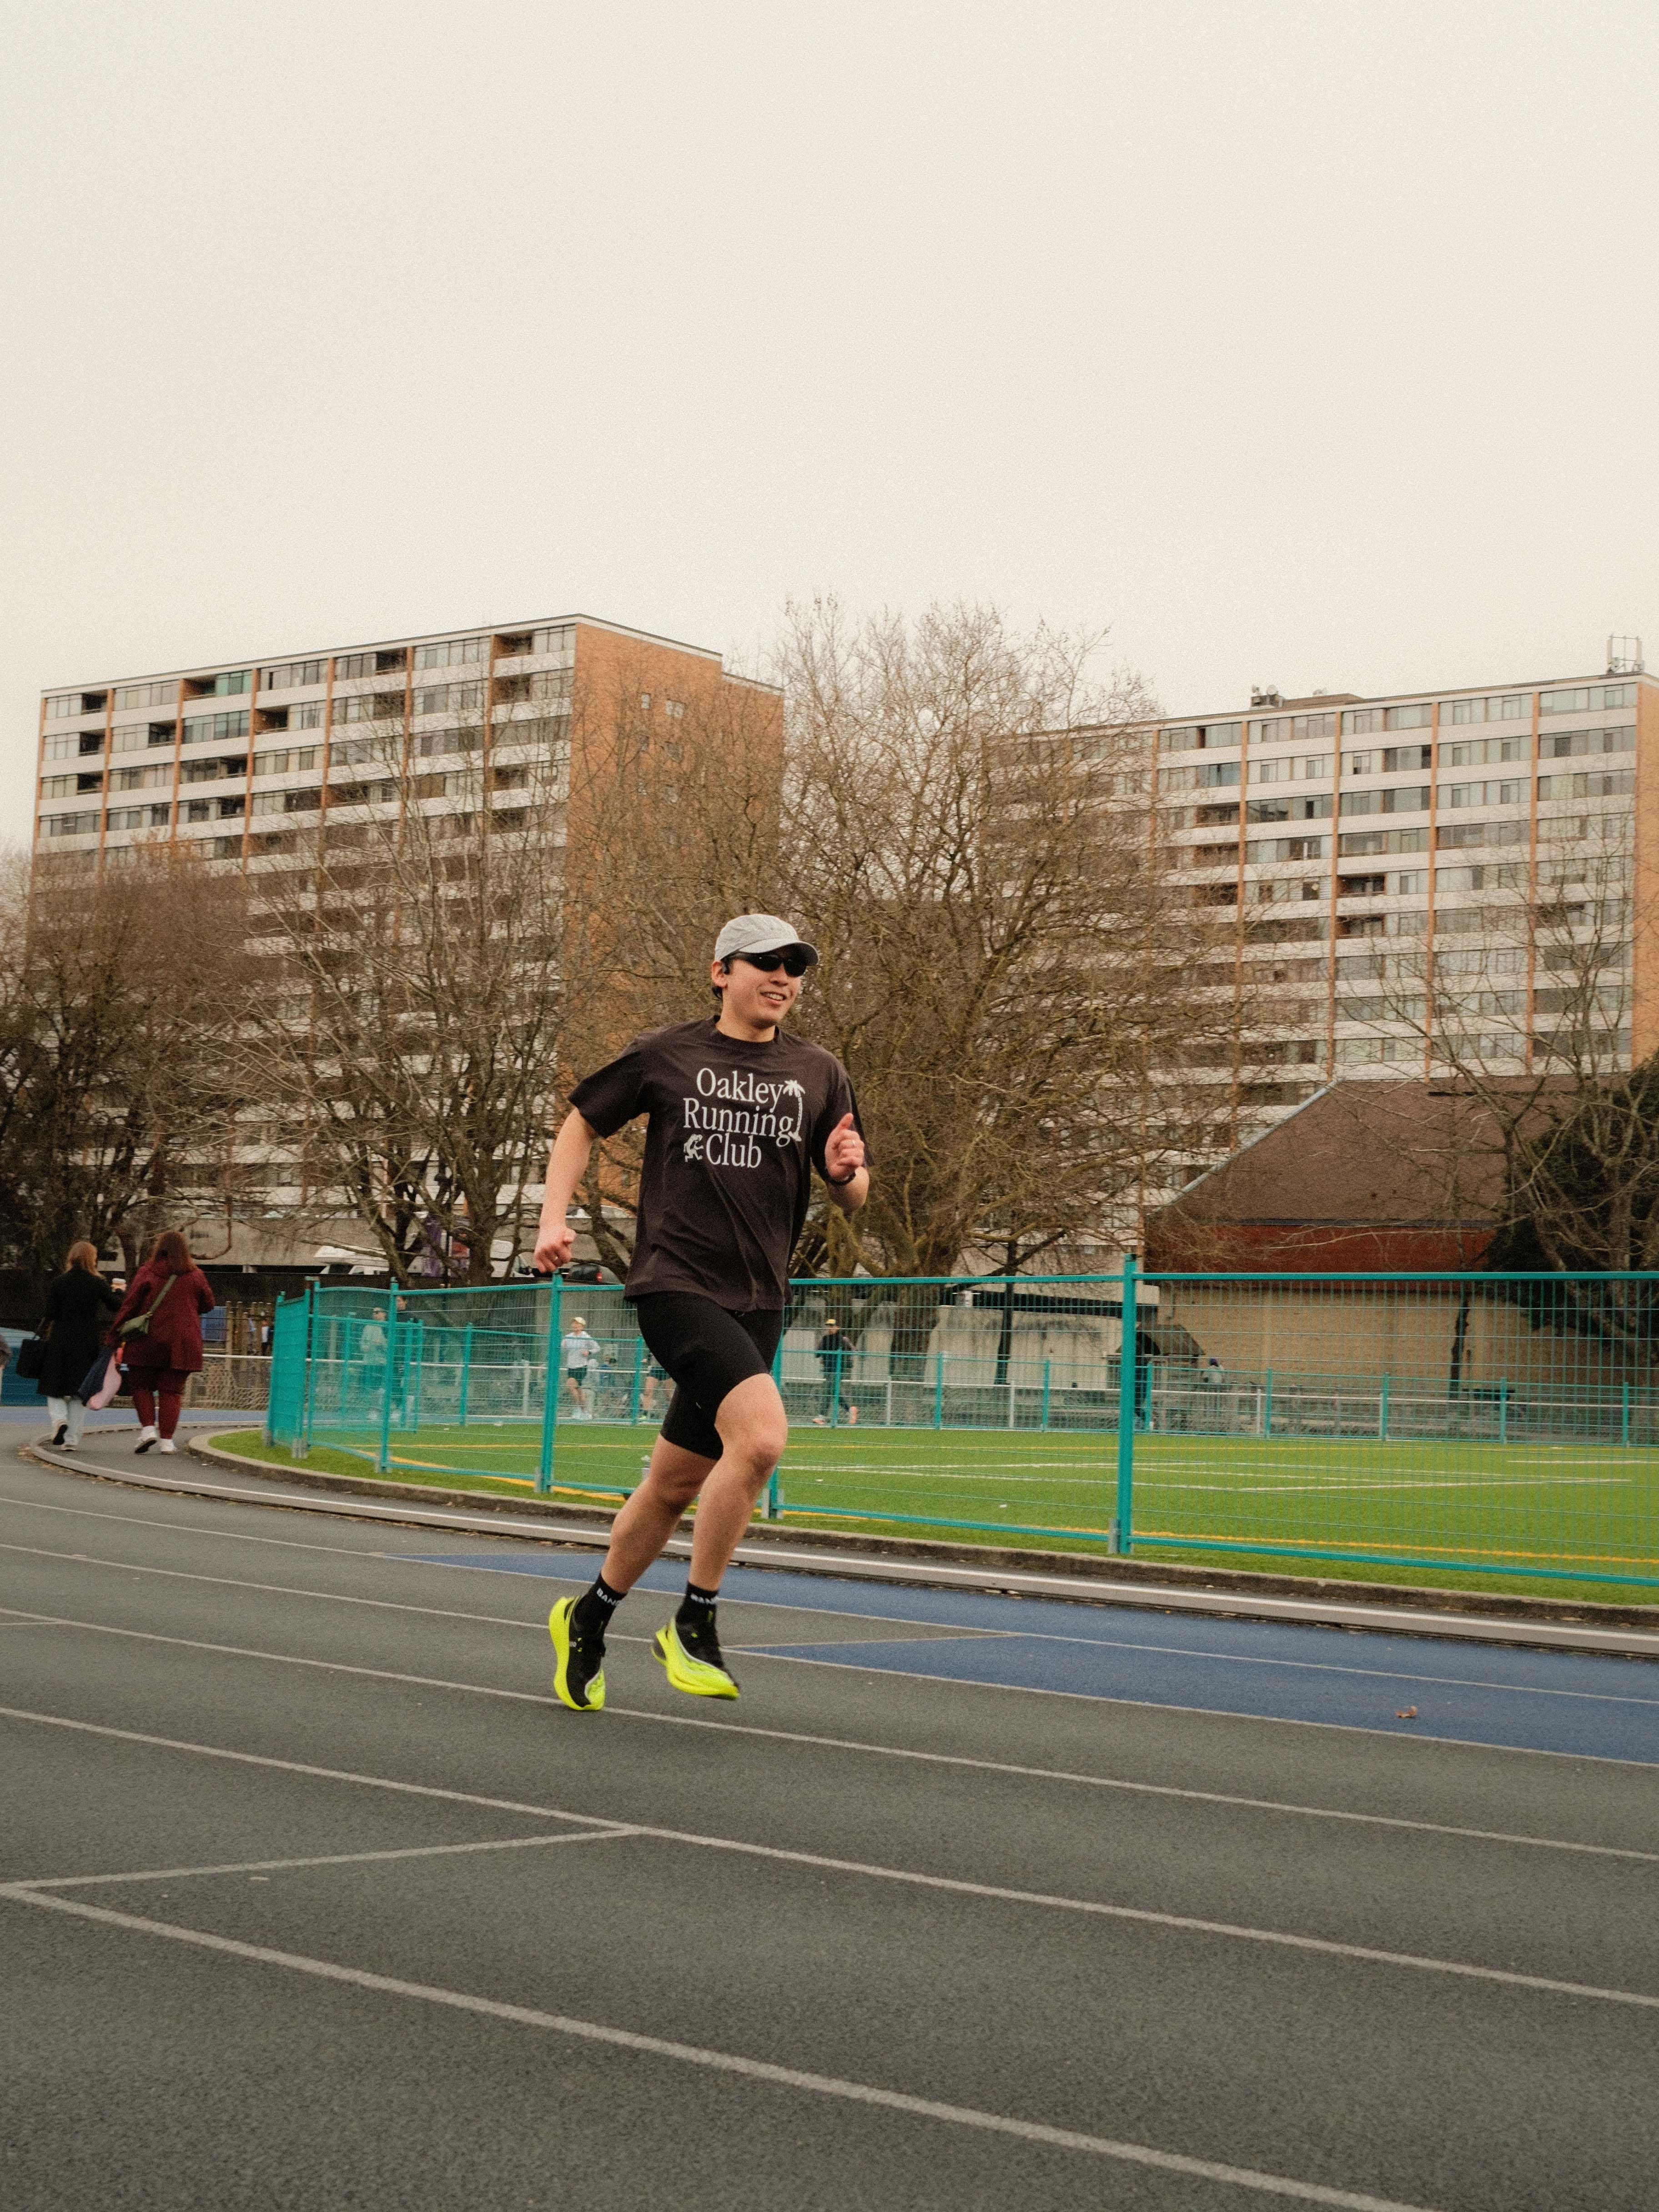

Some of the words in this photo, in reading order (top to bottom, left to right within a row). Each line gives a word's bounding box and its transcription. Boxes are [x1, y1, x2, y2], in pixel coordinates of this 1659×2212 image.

[697, 1068, 784, 1113] Oakley
[683, 1097, 794, 1147] Running
[706, 1133, 761, 1168] Club
